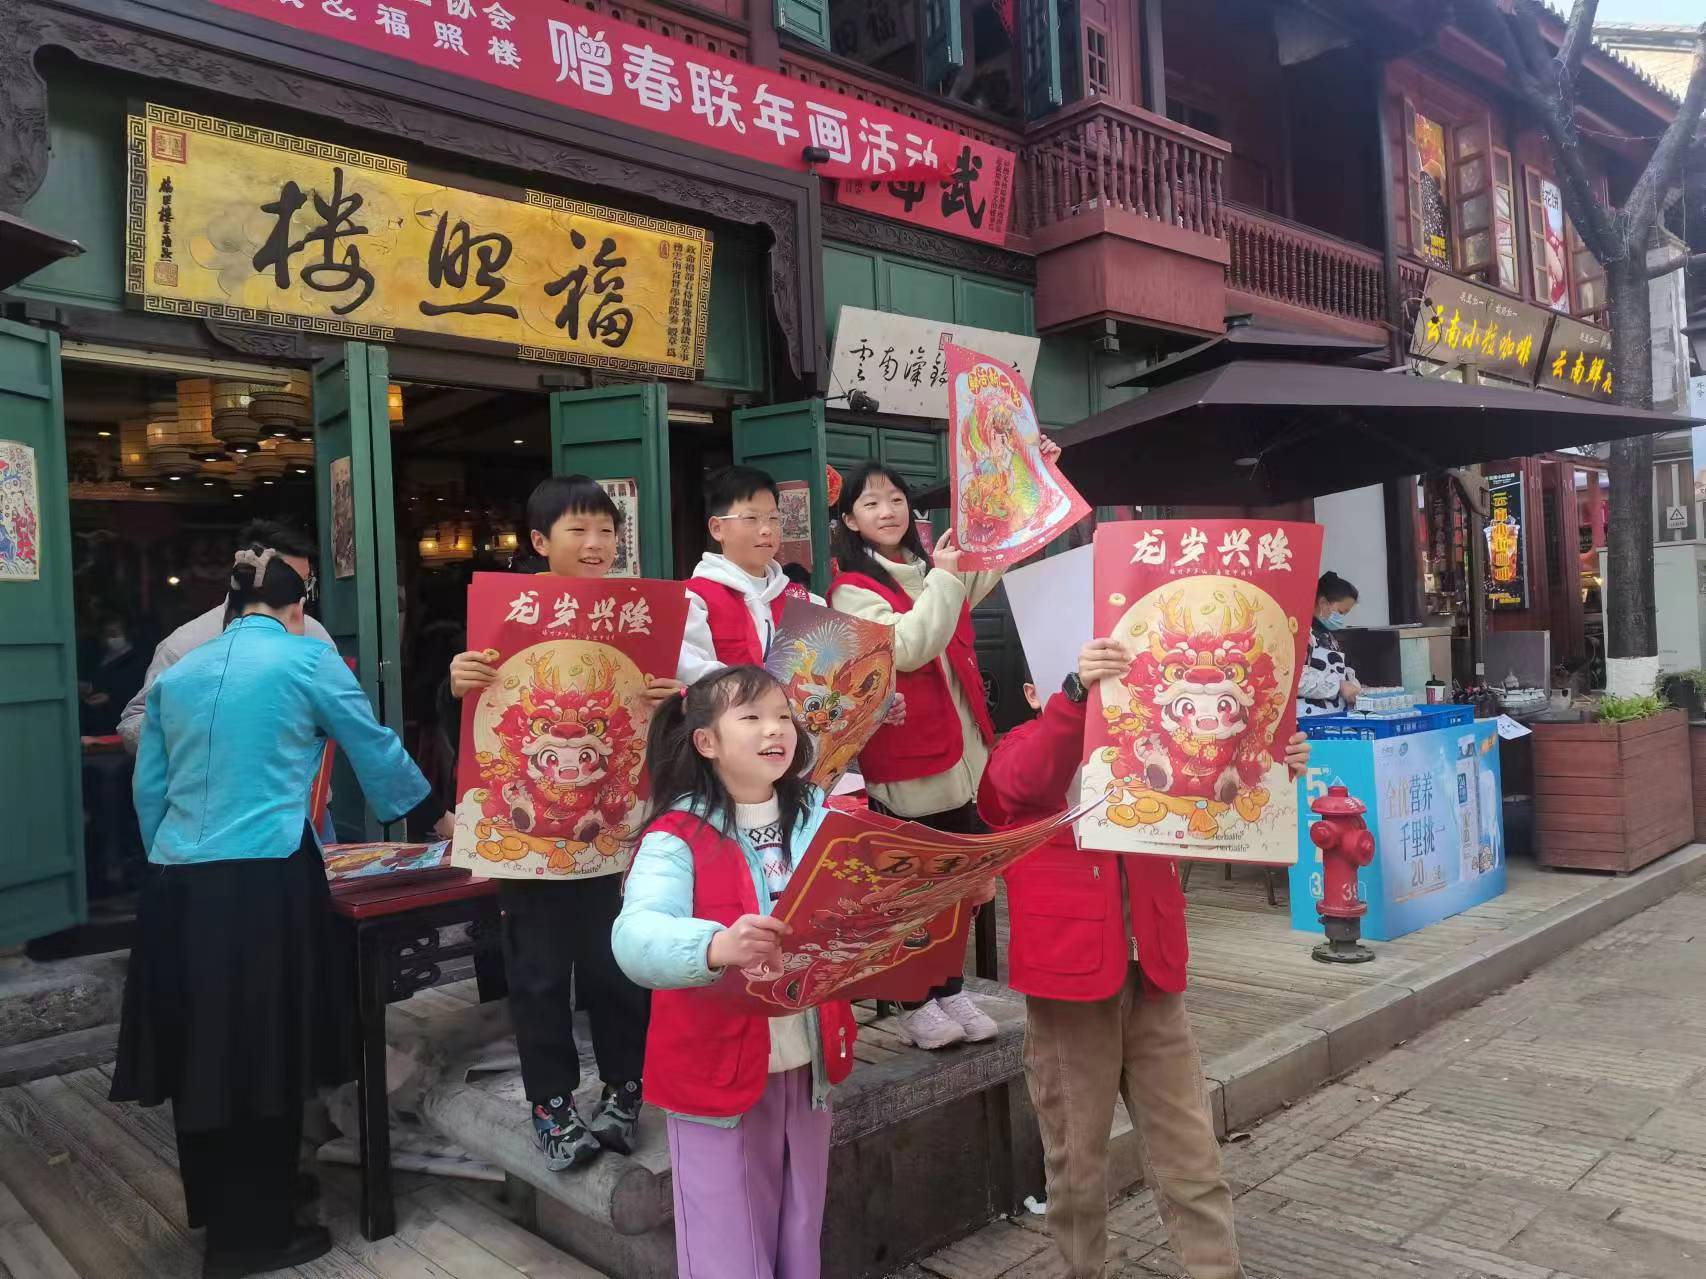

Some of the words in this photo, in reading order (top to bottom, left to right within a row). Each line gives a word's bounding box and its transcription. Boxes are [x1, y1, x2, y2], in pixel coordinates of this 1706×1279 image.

[1129, 527, 1293, 572] 龙岁兴隆
[503, 590, 653, 636] 龙岁兴隆
[1399, 815, 1446, 862] 千里挑一
